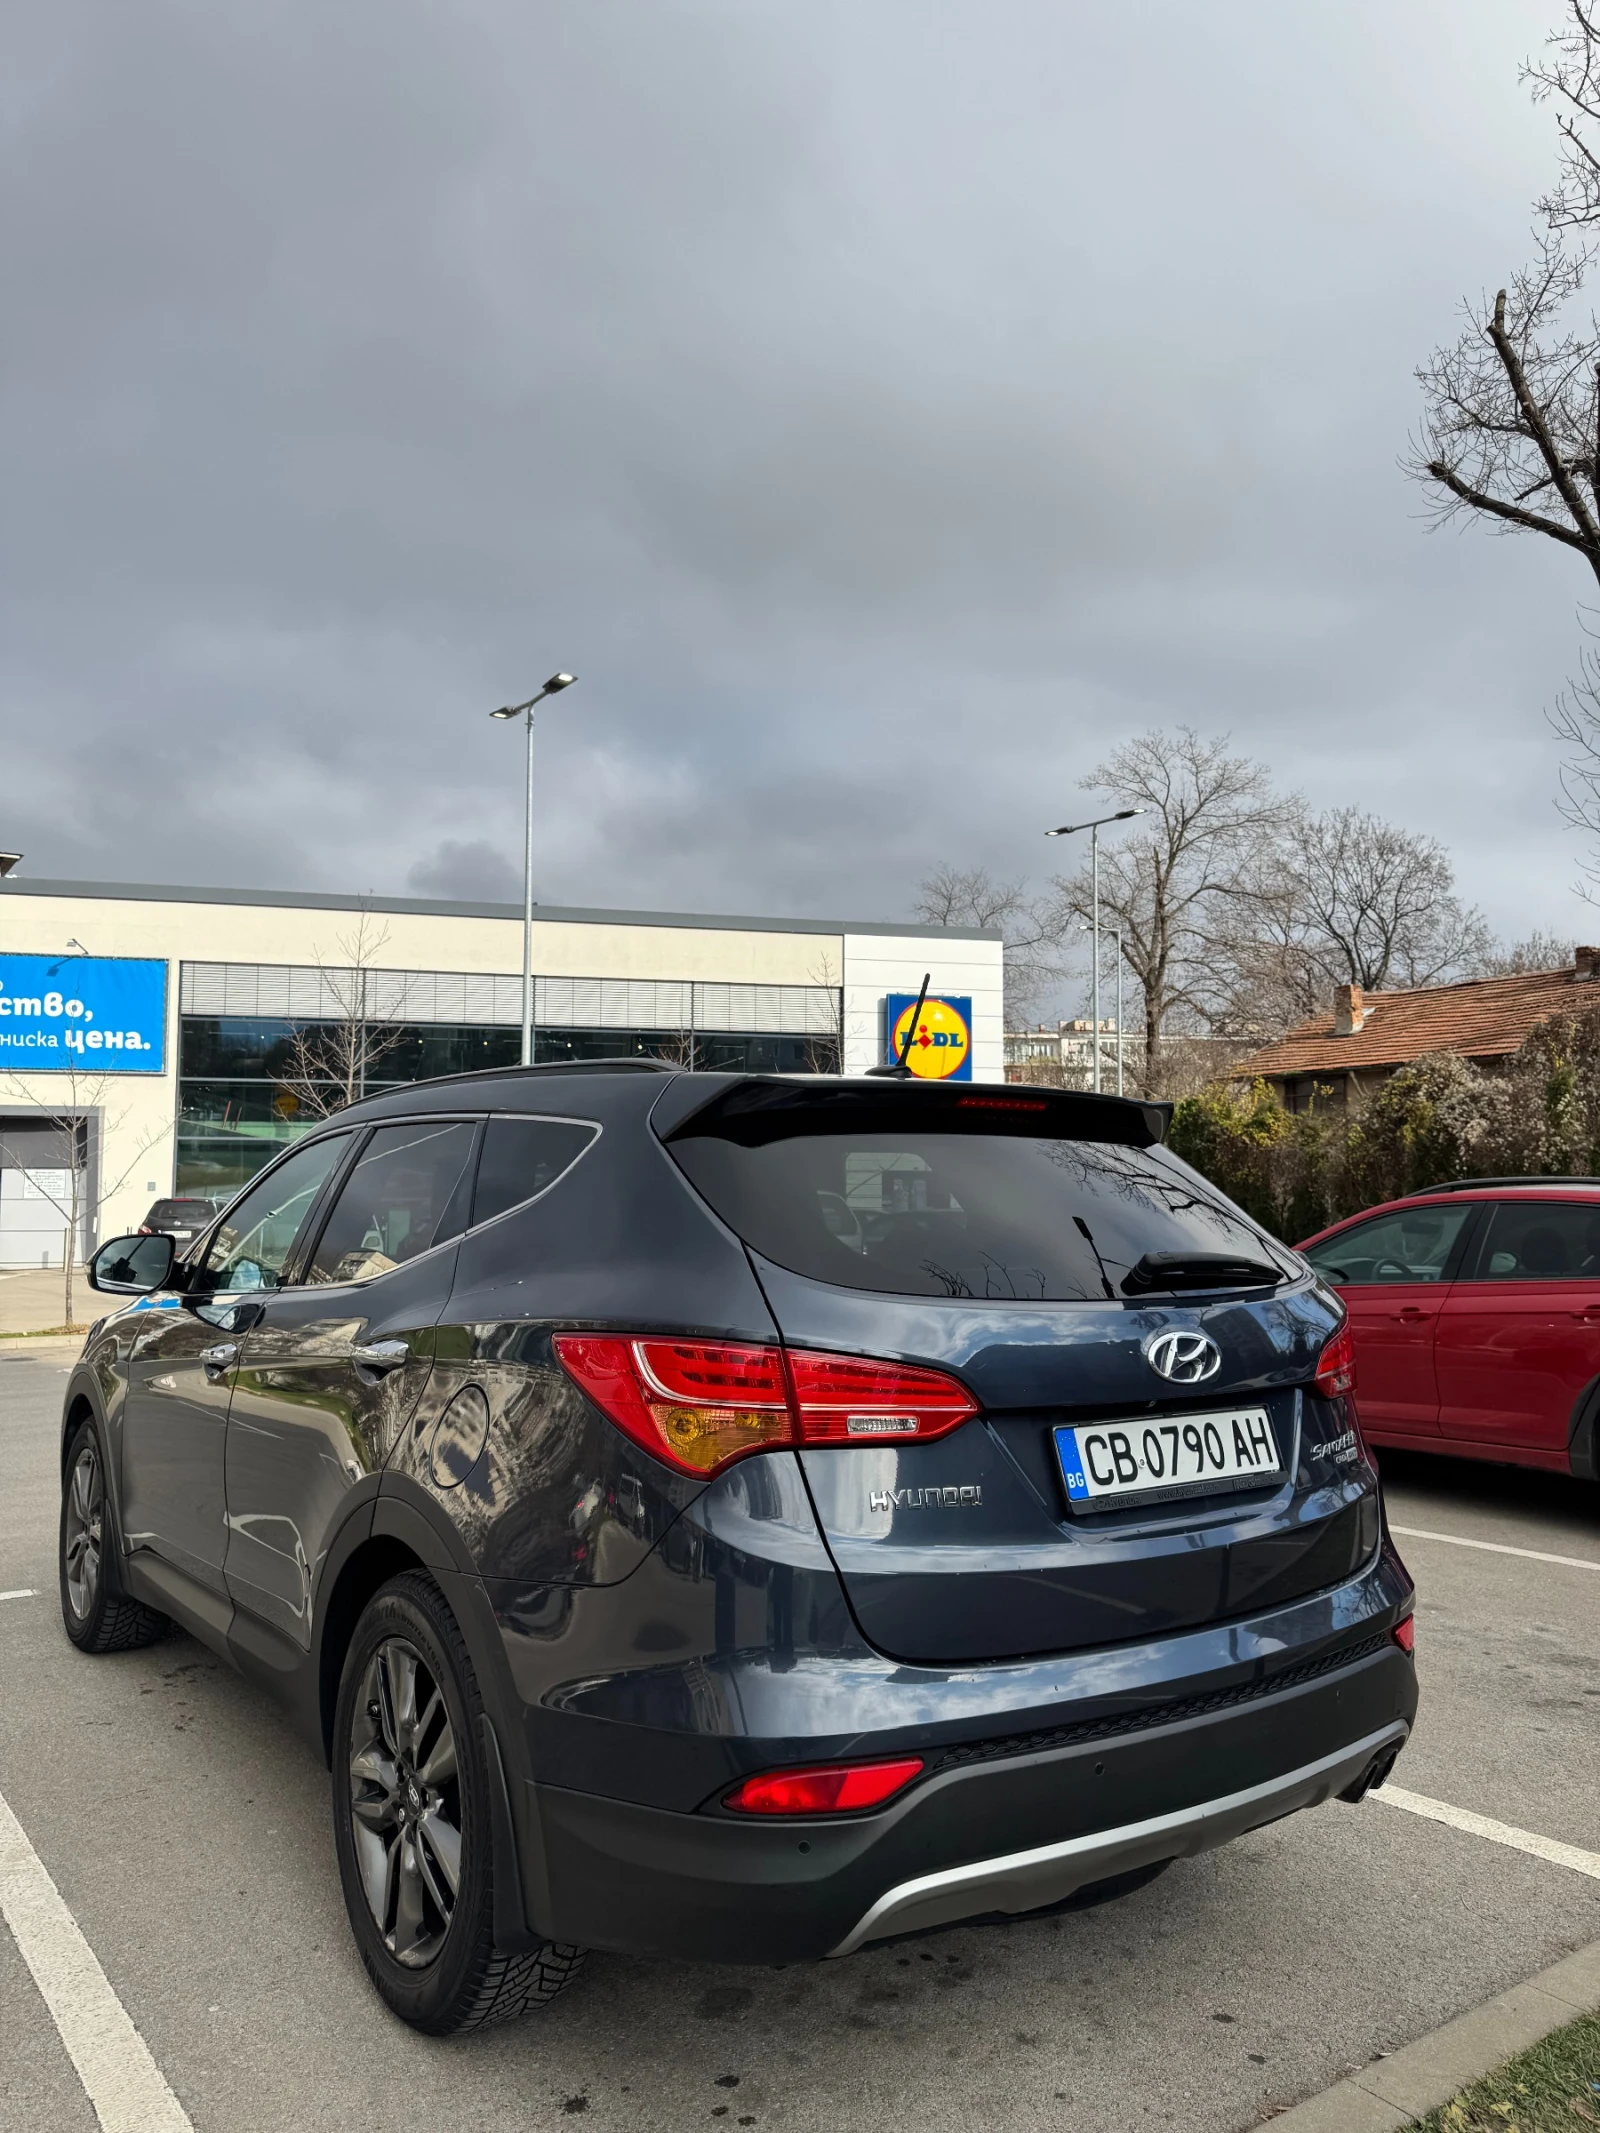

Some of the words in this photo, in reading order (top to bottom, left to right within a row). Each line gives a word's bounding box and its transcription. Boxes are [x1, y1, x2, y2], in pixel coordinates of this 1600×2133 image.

[65, 1029, 151, 1054] цена.
[1143, 1422, 1225, 1478] 0790
[1231, 1416, 1274, 1468] AH
[1067, 1472, 1085, 1489] BG
[869, 1485, 982, 1512] HYUNDAI
